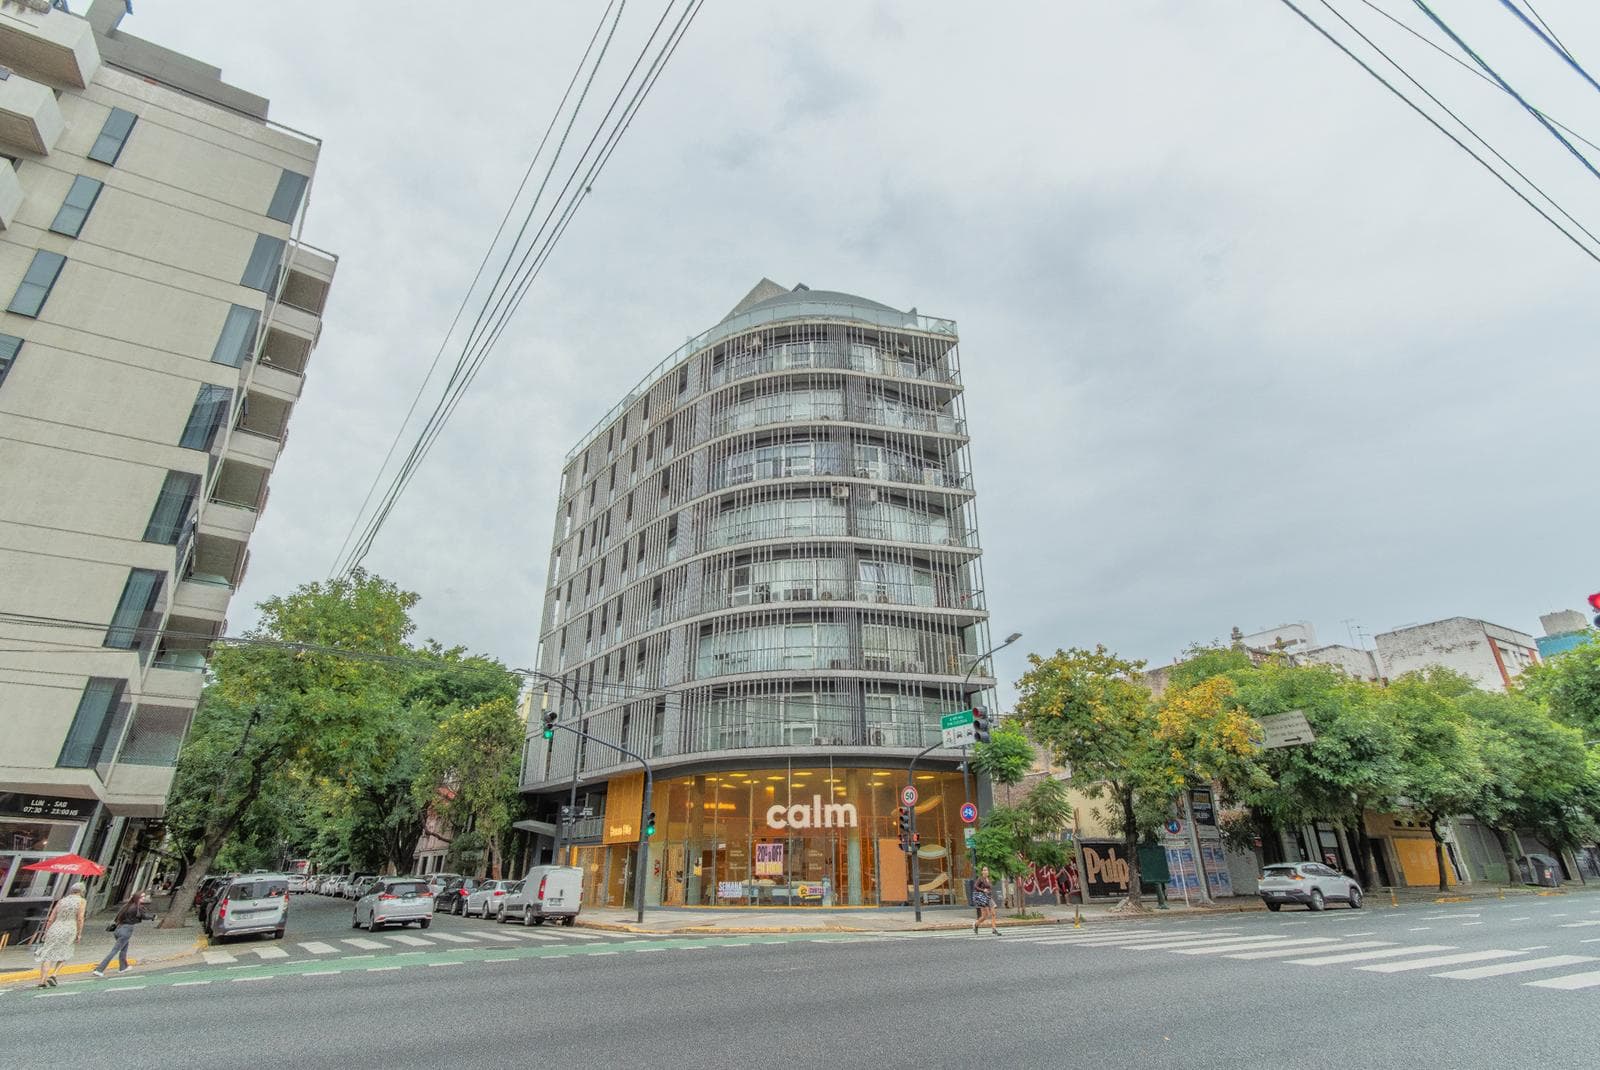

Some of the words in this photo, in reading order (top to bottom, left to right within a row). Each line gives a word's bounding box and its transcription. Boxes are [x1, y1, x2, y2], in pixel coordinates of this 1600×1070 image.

[767, 795, 857, 829] calm
[906, 792, 914, 800] 50
[1082, 847, 1130, 890] Pulp
